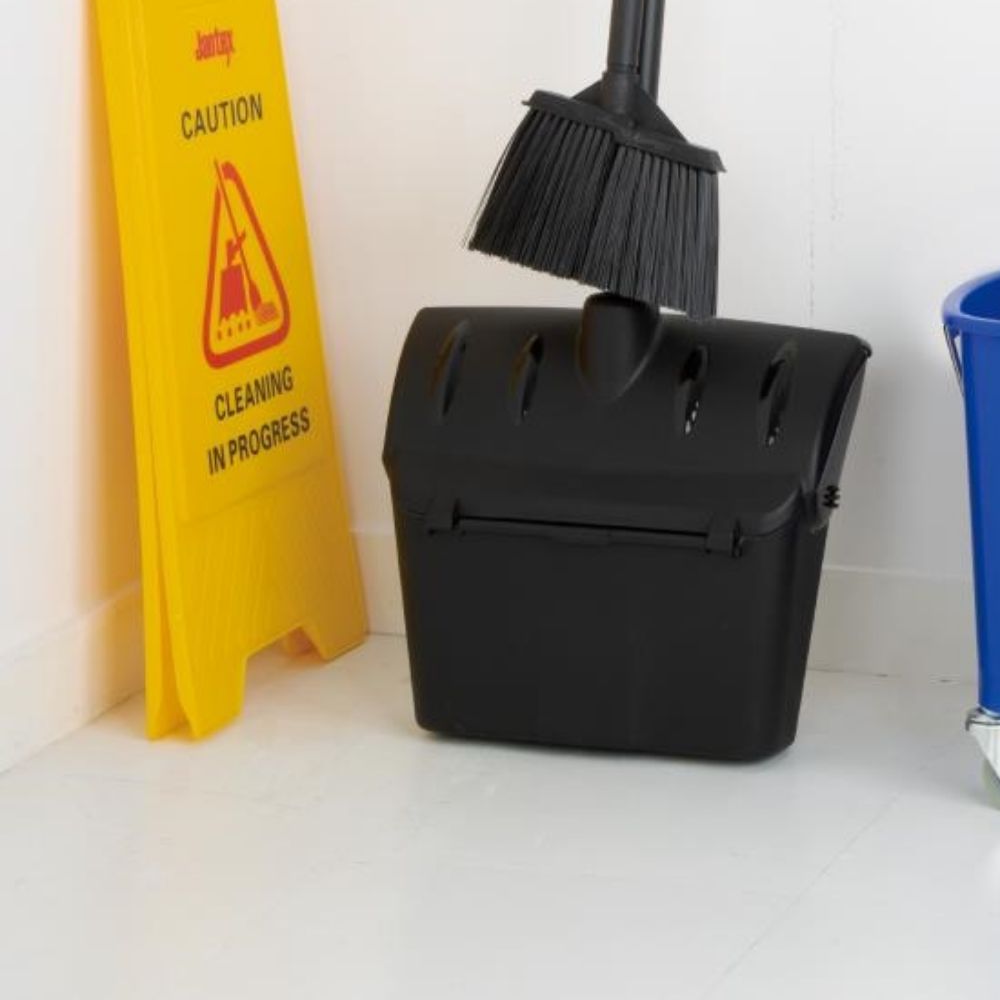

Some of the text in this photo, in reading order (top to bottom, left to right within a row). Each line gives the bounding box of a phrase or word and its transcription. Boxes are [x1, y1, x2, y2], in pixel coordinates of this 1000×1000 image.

[181, 93, 263, 140] CAUTION
[214, 365, 294, 421] CLEANING
[207, 406, 311, 476] IN PROGRESS
